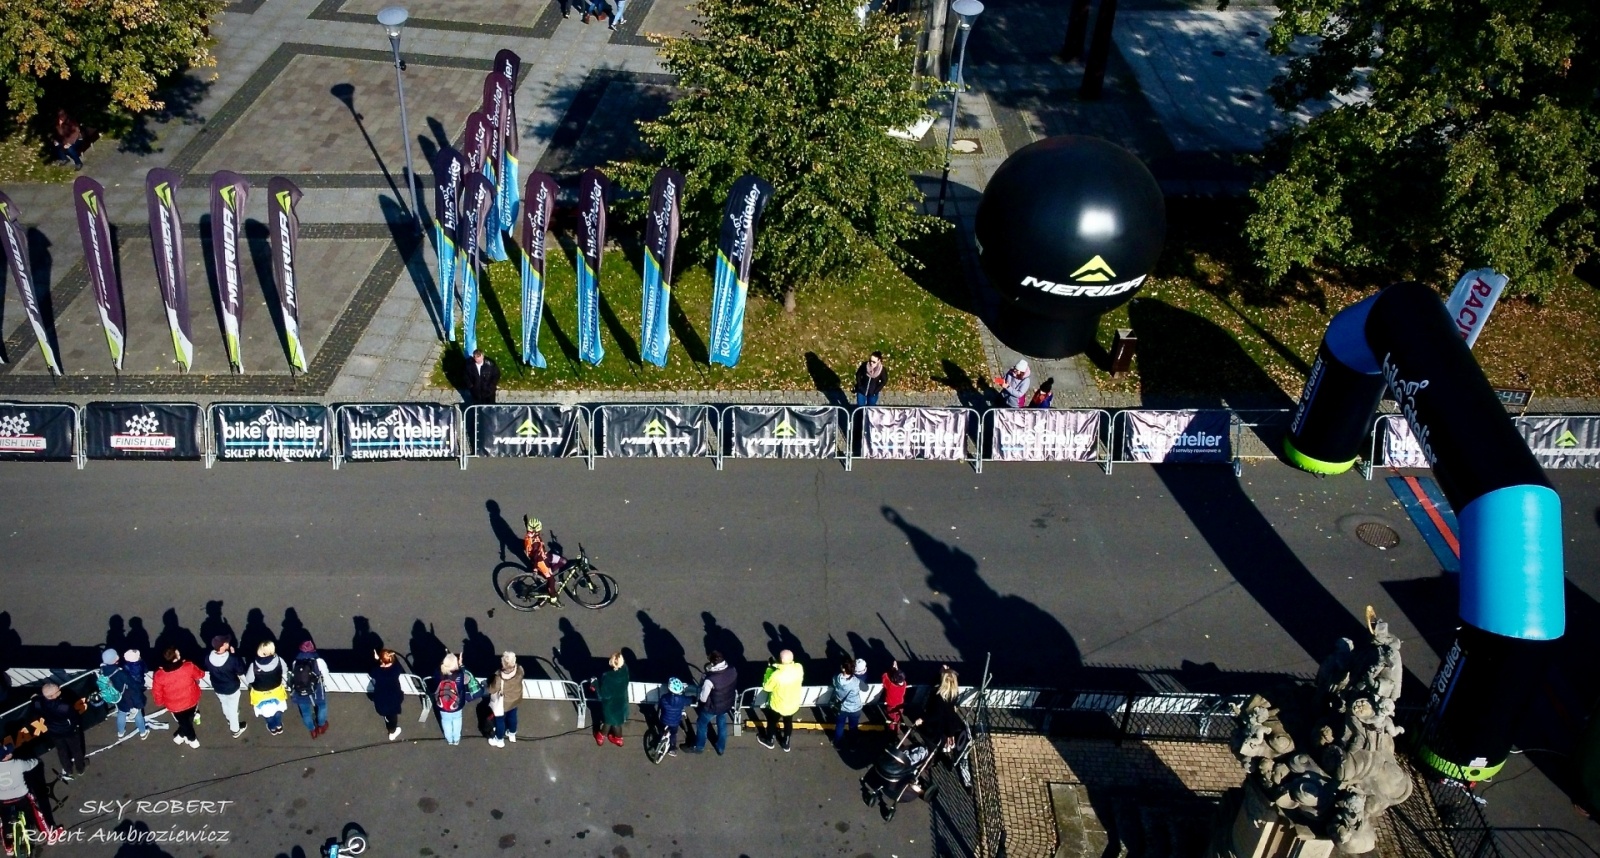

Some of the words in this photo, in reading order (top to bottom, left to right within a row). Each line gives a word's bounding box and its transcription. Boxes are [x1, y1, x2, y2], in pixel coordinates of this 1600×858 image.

[741, 183, 762, 230] atelier
[222, 206, 239, 308] MERIDA
[278, 210, 296, 309] MERIDA
[1020, 273, 1147, 298] MERIDA
[1303, 353, 1324, 401] atelier
[1382, 351, 1403, 404] bike
[224, 421, 262, 440] bike
[266, 421, 323, 440] atelier
[350, 422, 389, 440] bike
[393, 421, 450, 439] atelier
[871, 428, 906, 443] bike
[909, 428, 958, 444] atelier
[1001, 431, 1036, 445] bike
[1039, 430, 1091, 445] atelier
[1133, 431, 1168, 446] bike
[1172, 431, 1223, 447] atelier
[20, 439, 42, 448] LINE
[115, 437, 147, 446] FINISH
[149, 438, 171, 447] LINE
[493, 437, 563, 446] MERIDA
[620, 437, 691, 446] MERIDA
[224, 448, 257, 459] SKLEP
[258, 448, 323, 459] ROWEROWY
[351, 449, 389, 459] SERWIS
[389, 448, 451, 458] ROWEROWY
[1437, 638, 1462, 693] atelier
